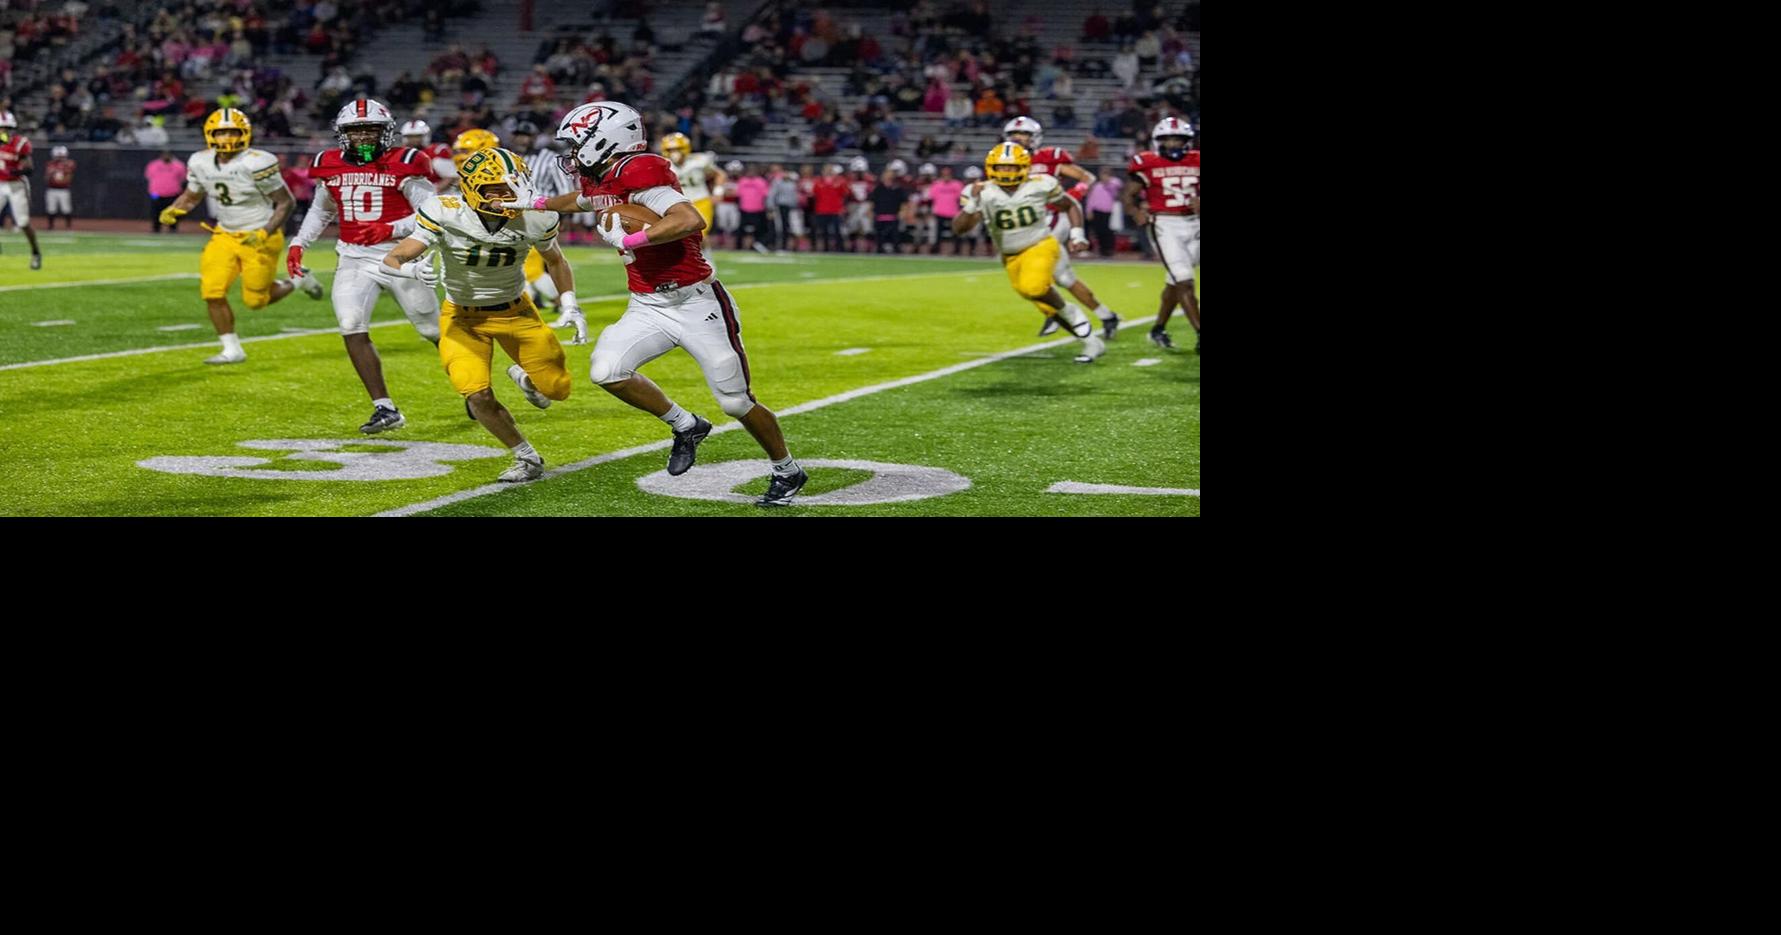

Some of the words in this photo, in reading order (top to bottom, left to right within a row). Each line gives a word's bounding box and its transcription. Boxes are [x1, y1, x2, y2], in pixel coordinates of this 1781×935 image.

[462, 152, 487, 175] B
[342, 172, 397, 187] HURRICANES
[214, 183, 233, 206] 3
[338, 186, 383, 222] 10
[995, 206, 1039, 229] 60
